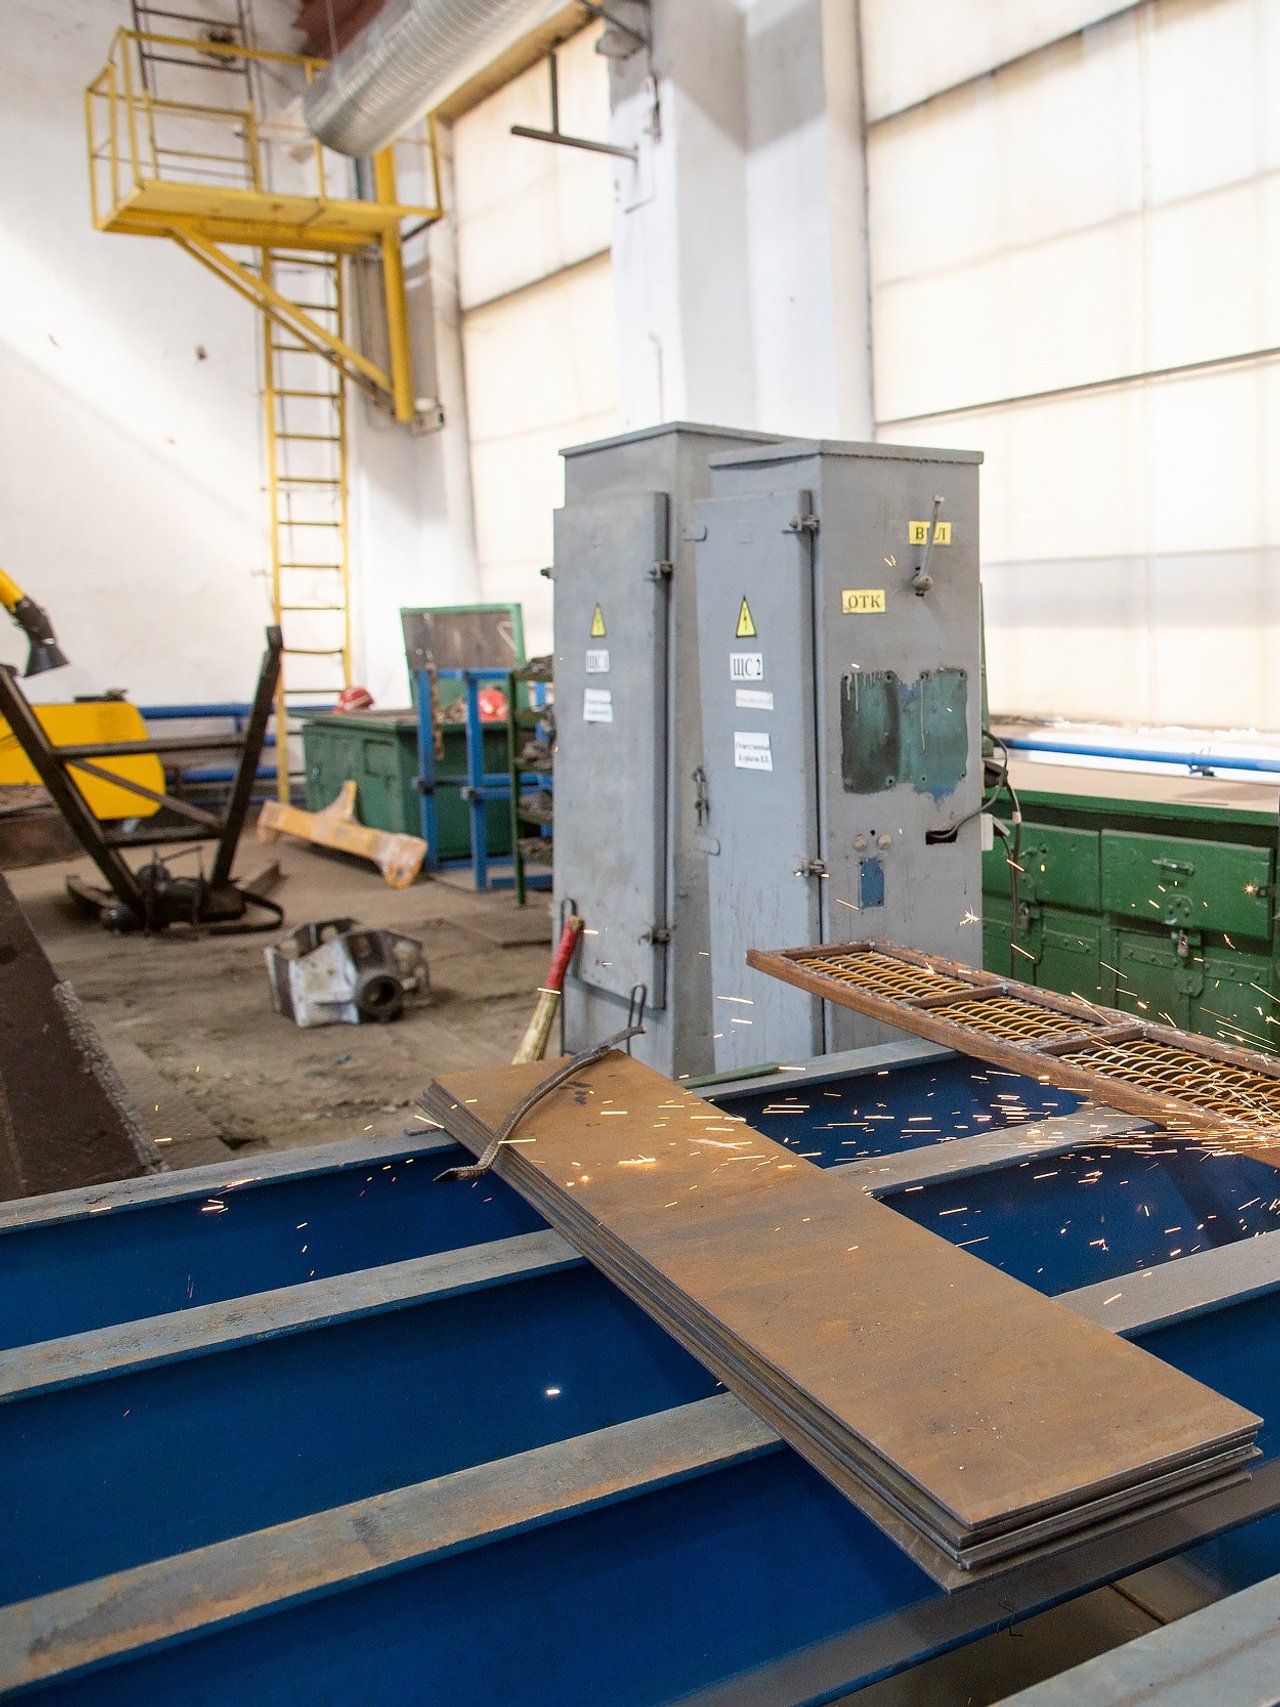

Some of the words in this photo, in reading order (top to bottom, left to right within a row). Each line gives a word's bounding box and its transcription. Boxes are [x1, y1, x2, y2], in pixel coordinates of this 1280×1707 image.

[915, 526, 946, 541] ВЛ
[848, 594, 881, 609] ОТК
[733, 658, 753, 678] ЩС
[756, 658, 762, 676] 2
